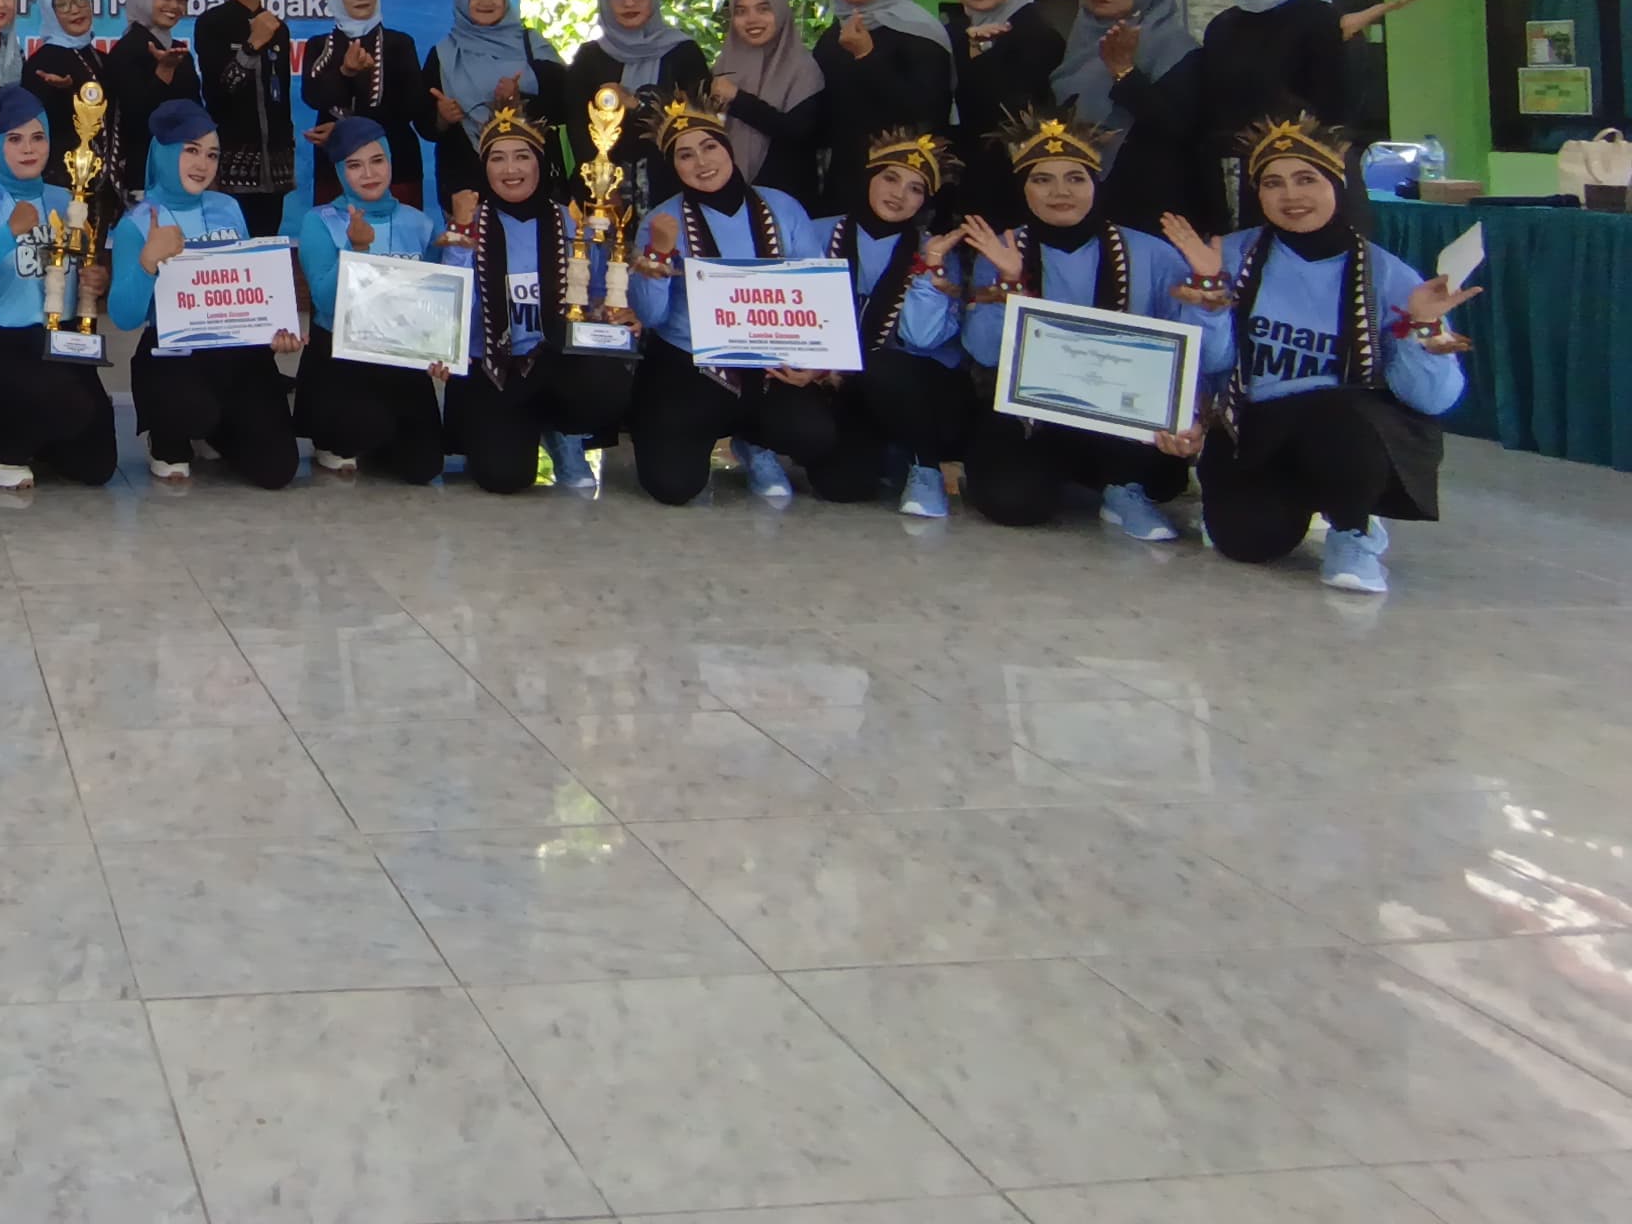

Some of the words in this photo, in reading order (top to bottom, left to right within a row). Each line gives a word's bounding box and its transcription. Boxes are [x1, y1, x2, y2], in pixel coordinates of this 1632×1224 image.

[191, 268, 240, 286] JUARA
[243, 268, 252, 283] 1
[177, 291, 201, 310] Rp.
[204, 287, 274, 307] 600.000,-
[729, 288, 786, 305] JUARA
[791, 289, 804, 305] 3
[714, 308, 742, 328] Rp.
[746, 309, 830, 330] 400.000,-
[1248, 315, 1340, 356] ena
